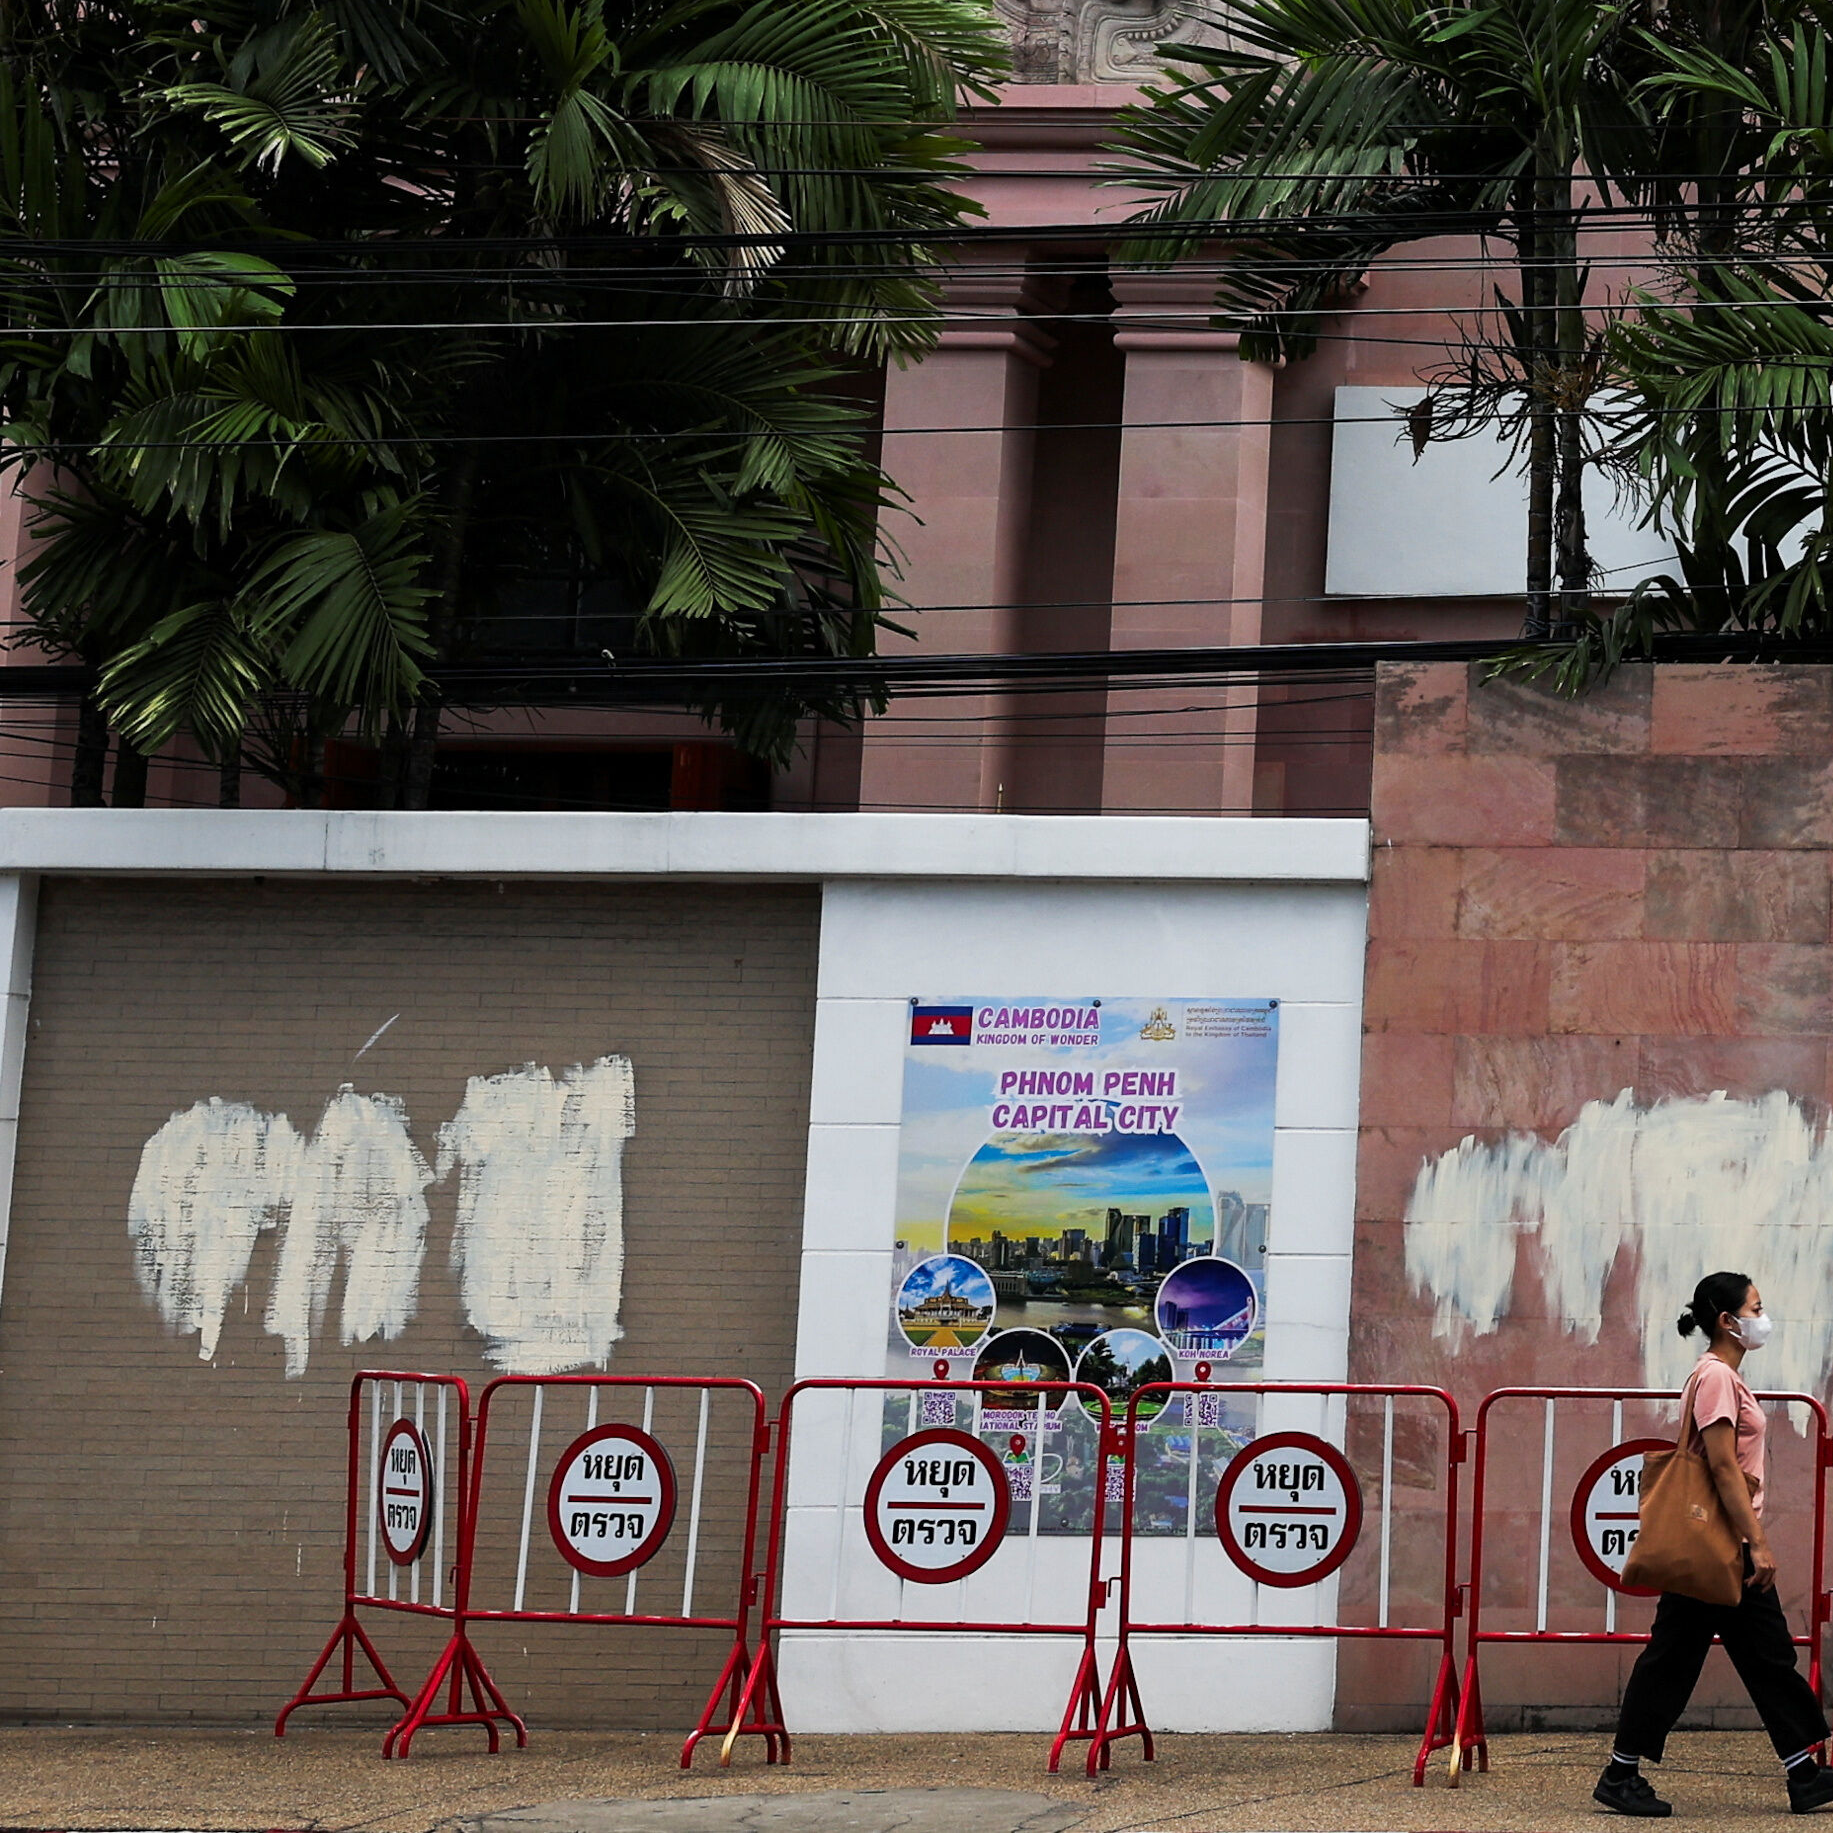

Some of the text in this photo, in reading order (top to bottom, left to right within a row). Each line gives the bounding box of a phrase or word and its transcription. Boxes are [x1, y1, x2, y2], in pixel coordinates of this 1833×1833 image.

[978, 1008, 1099, 1029] CAMBODIA
[976, 1034, 1099, 1045] KINGDOM OF WONDER
[1001, 1071, 1175, 1096] PHNOM PENH
[992, 1104, 1179, 1130] CAPITAL CITY
[911, 1348, 976, 1356] ROYAL PALACE
[1179, 1350, 1228, 1358] KOH NOREA
[983, 1412, 1055, 1420] MORODOK TEHO
[391, 1448, 416, 1484] หยุด
[583, 1455, 644, 1492] หยุด
[905, 1461, 976, 1498] หยุด
[1254, 1464, 1325, 1502] หยุด
[388, 1504, 417, 1531] ตรวจ
[571, 1513, 644, 1538] ตรวจ
[892, 1519, 977, 1546] ตรวจ
[1245, 1523, 1328, 1550] ตรวจ
